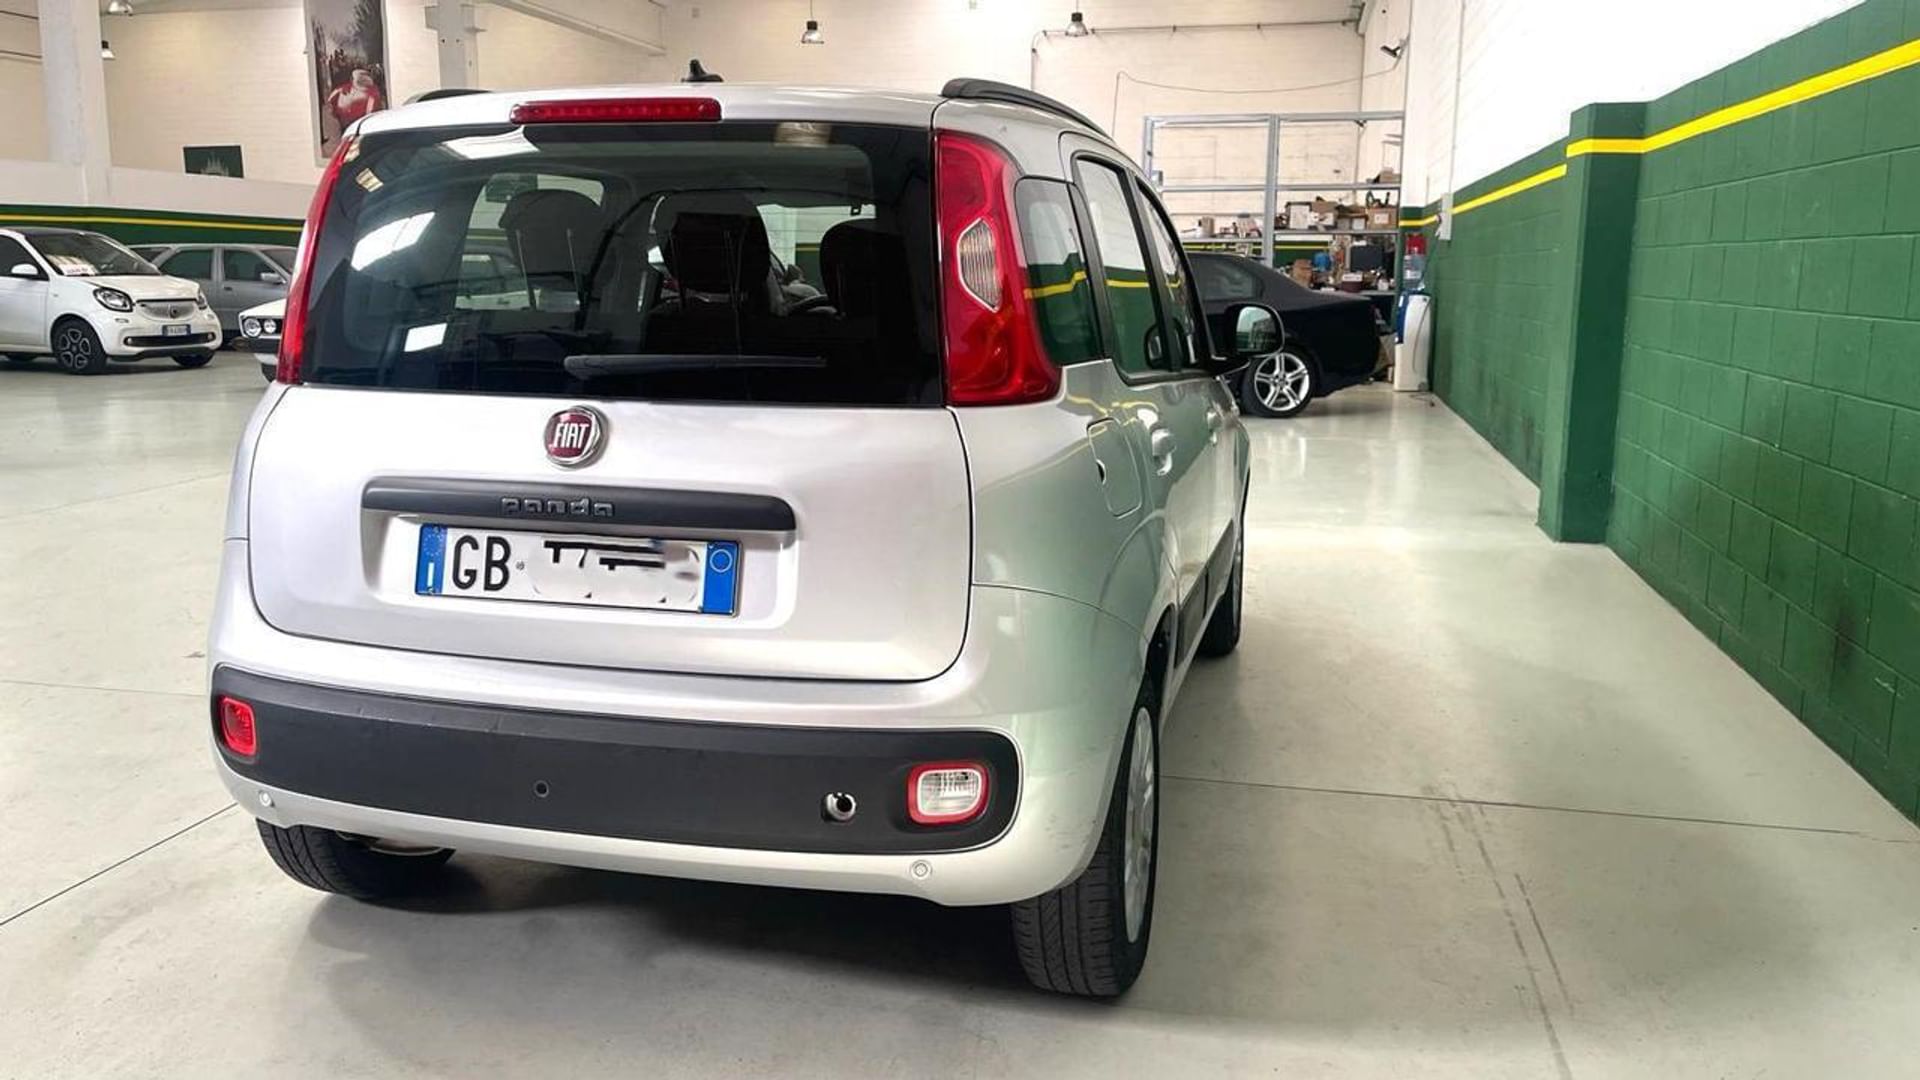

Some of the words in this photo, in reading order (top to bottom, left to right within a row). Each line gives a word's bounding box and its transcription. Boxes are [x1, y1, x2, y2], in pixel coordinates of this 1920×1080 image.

[553, 422, 590, 449] FIAT
[501, 497, 614, 517] panda
[452, 535, 511, 592] GB
